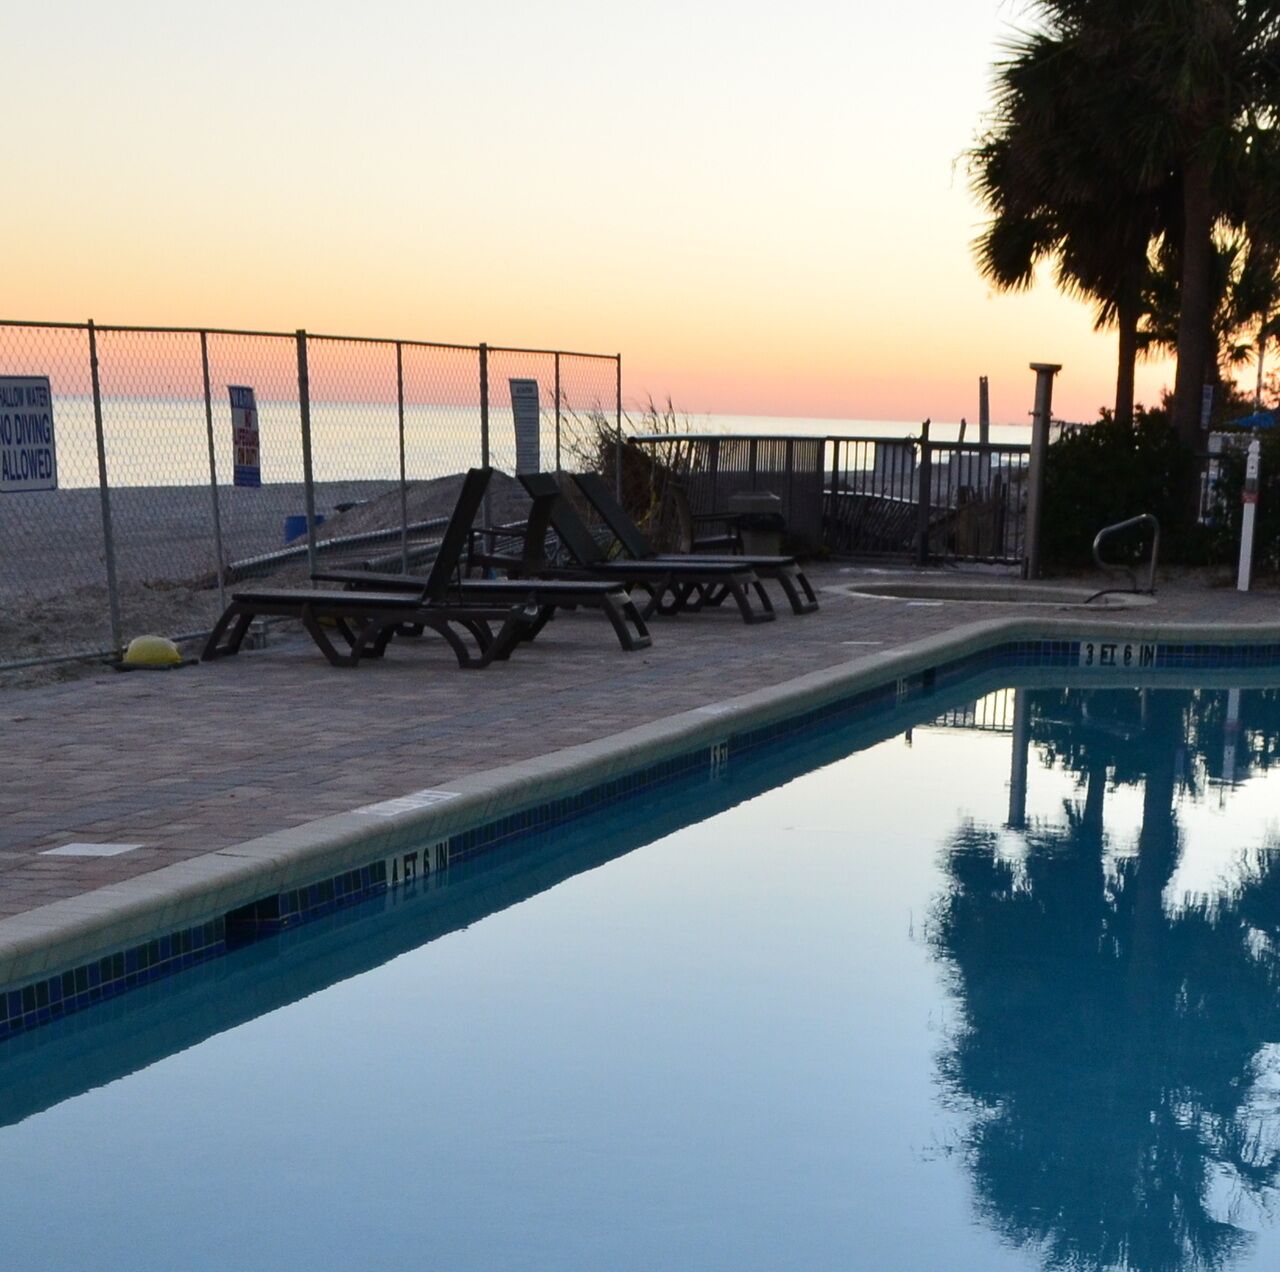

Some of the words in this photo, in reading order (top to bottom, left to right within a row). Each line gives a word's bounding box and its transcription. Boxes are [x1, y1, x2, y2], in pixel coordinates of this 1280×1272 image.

[26, 386, 48, 407] WATER
[14, 413, 51, 445] DIVING
[2, 448, 52, 481] ALLOWED
[404, 851, 418, 877] FT
[435, 841, 447, 870] IN
